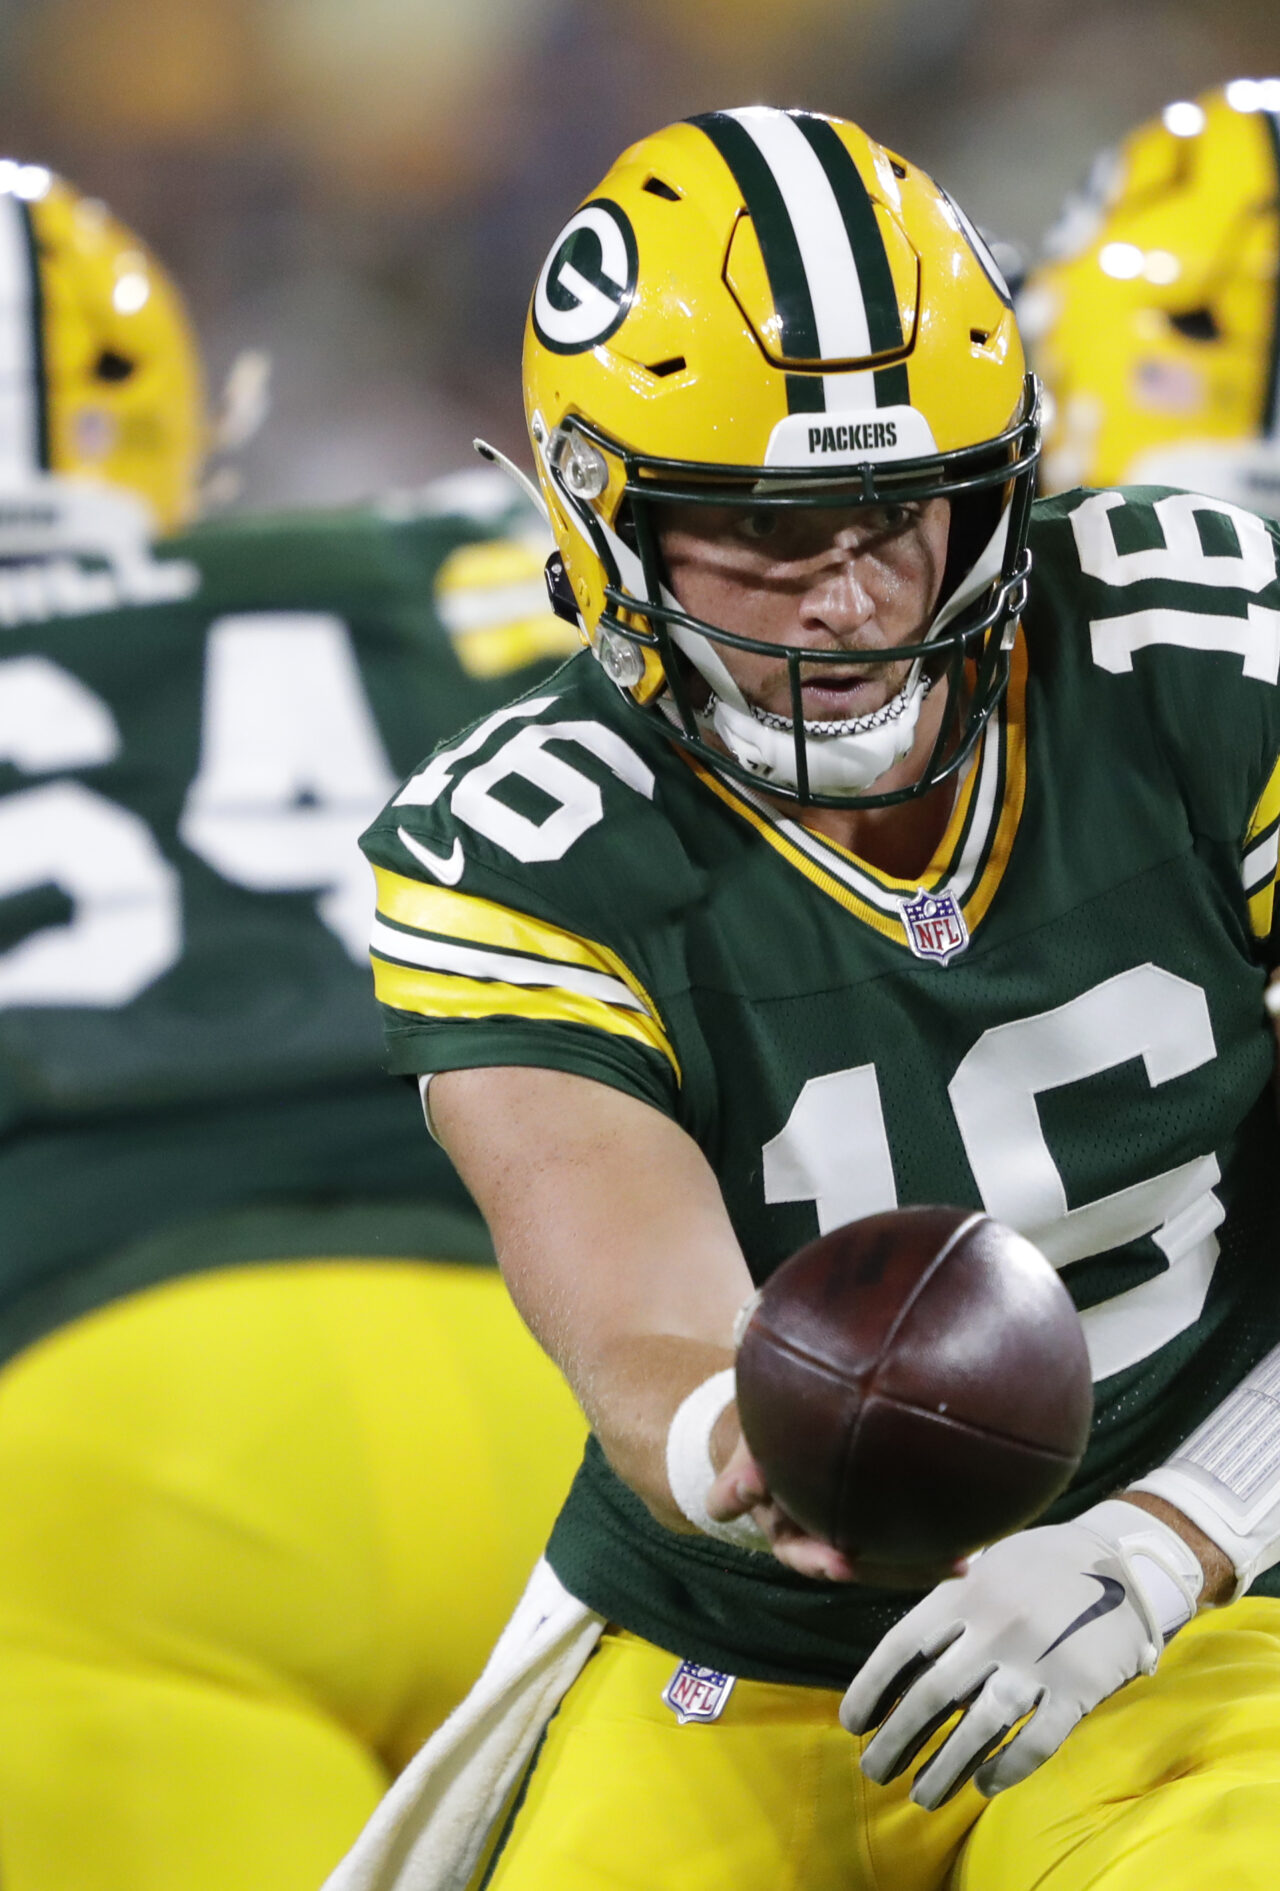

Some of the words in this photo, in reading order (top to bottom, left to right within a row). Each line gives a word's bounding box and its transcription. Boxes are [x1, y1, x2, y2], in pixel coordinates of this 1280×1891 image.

[808, 422, 897, 453] PACKERS
[392, 696, 655, 864] 16
[915, 918, 960, 951] NFL
[762, 961, 1226, 1384] 16
[673, 1675, 715, 1712] NFL
